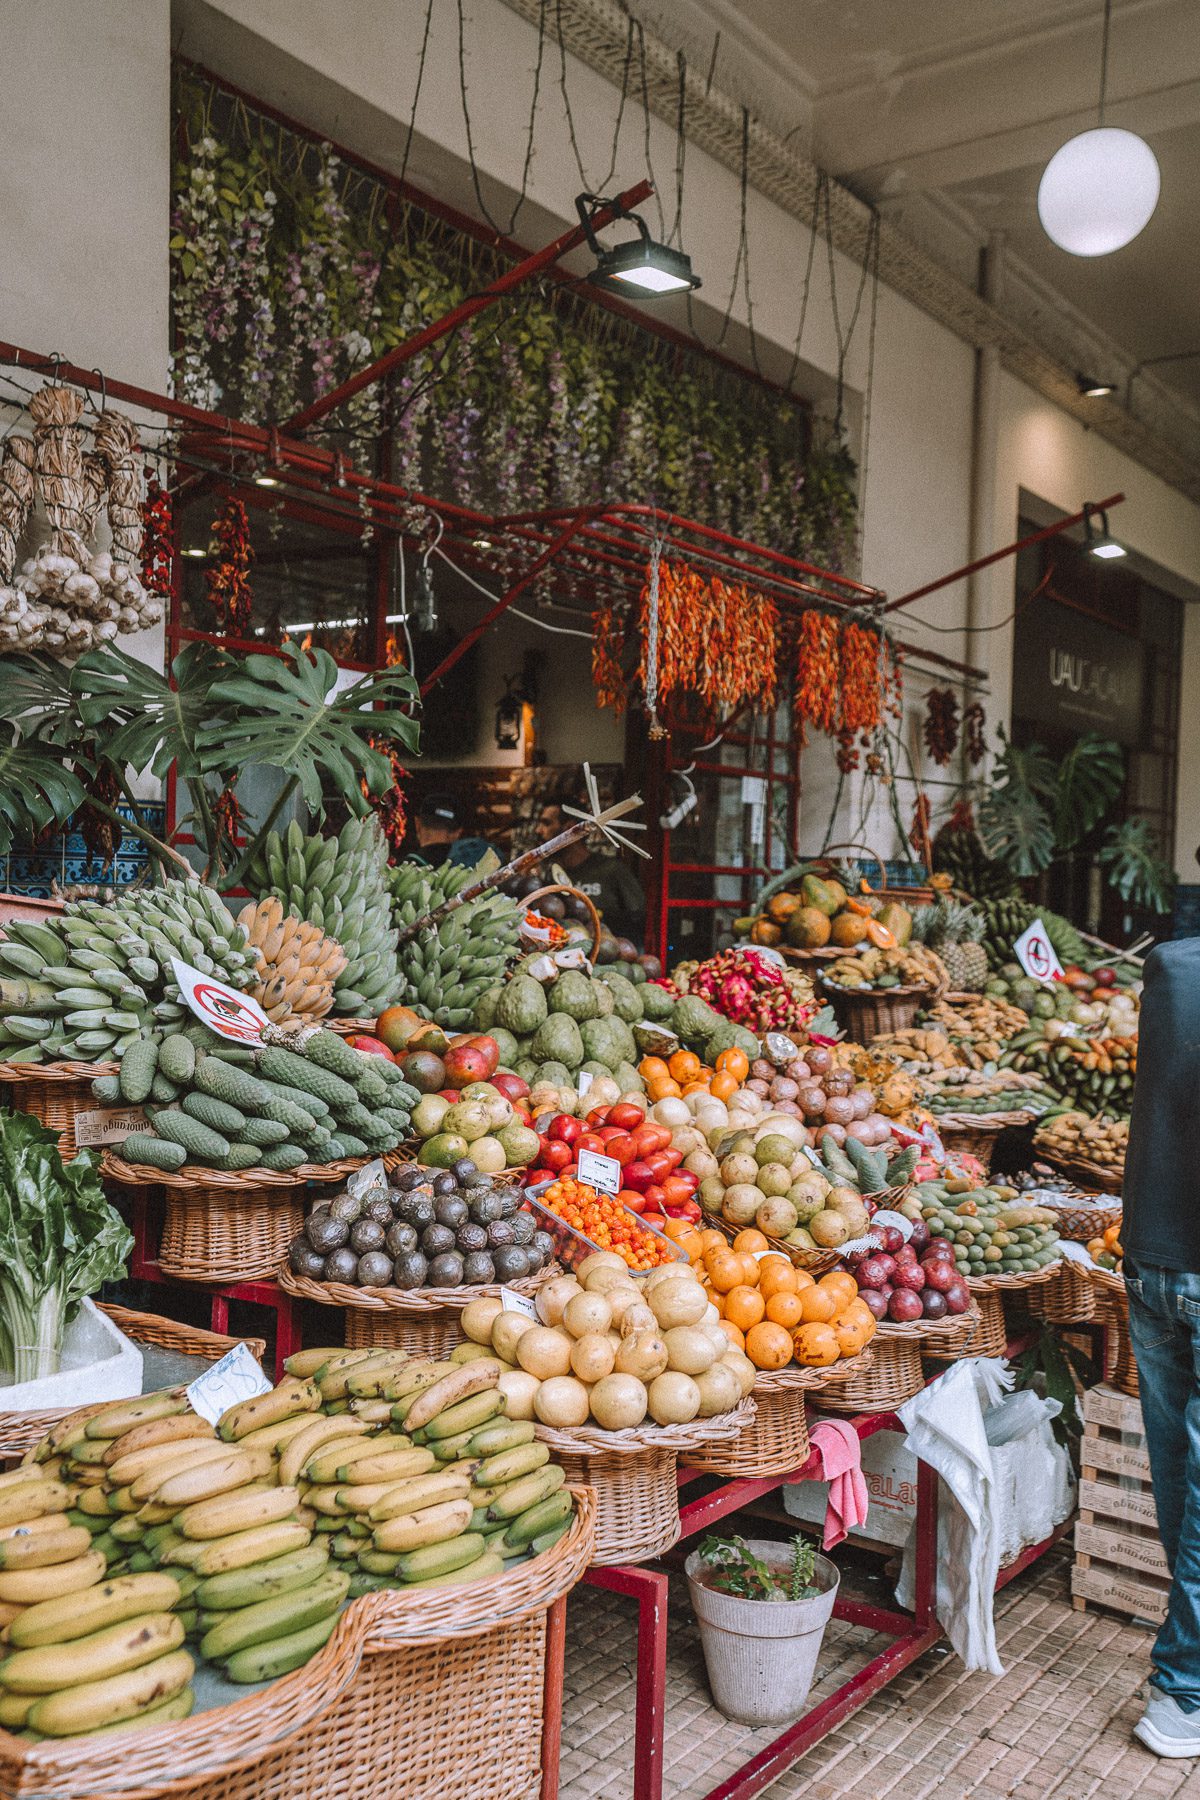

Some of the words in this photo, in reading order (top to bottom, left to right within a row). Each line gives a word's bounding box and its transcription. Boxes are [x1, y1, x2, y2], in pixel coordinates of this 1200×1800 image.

[103, 1119, 149, 1133] amorango
[1110, 1543, 1167, 1568] amorango
[1104, 1586, 1160, 1613] amorango
